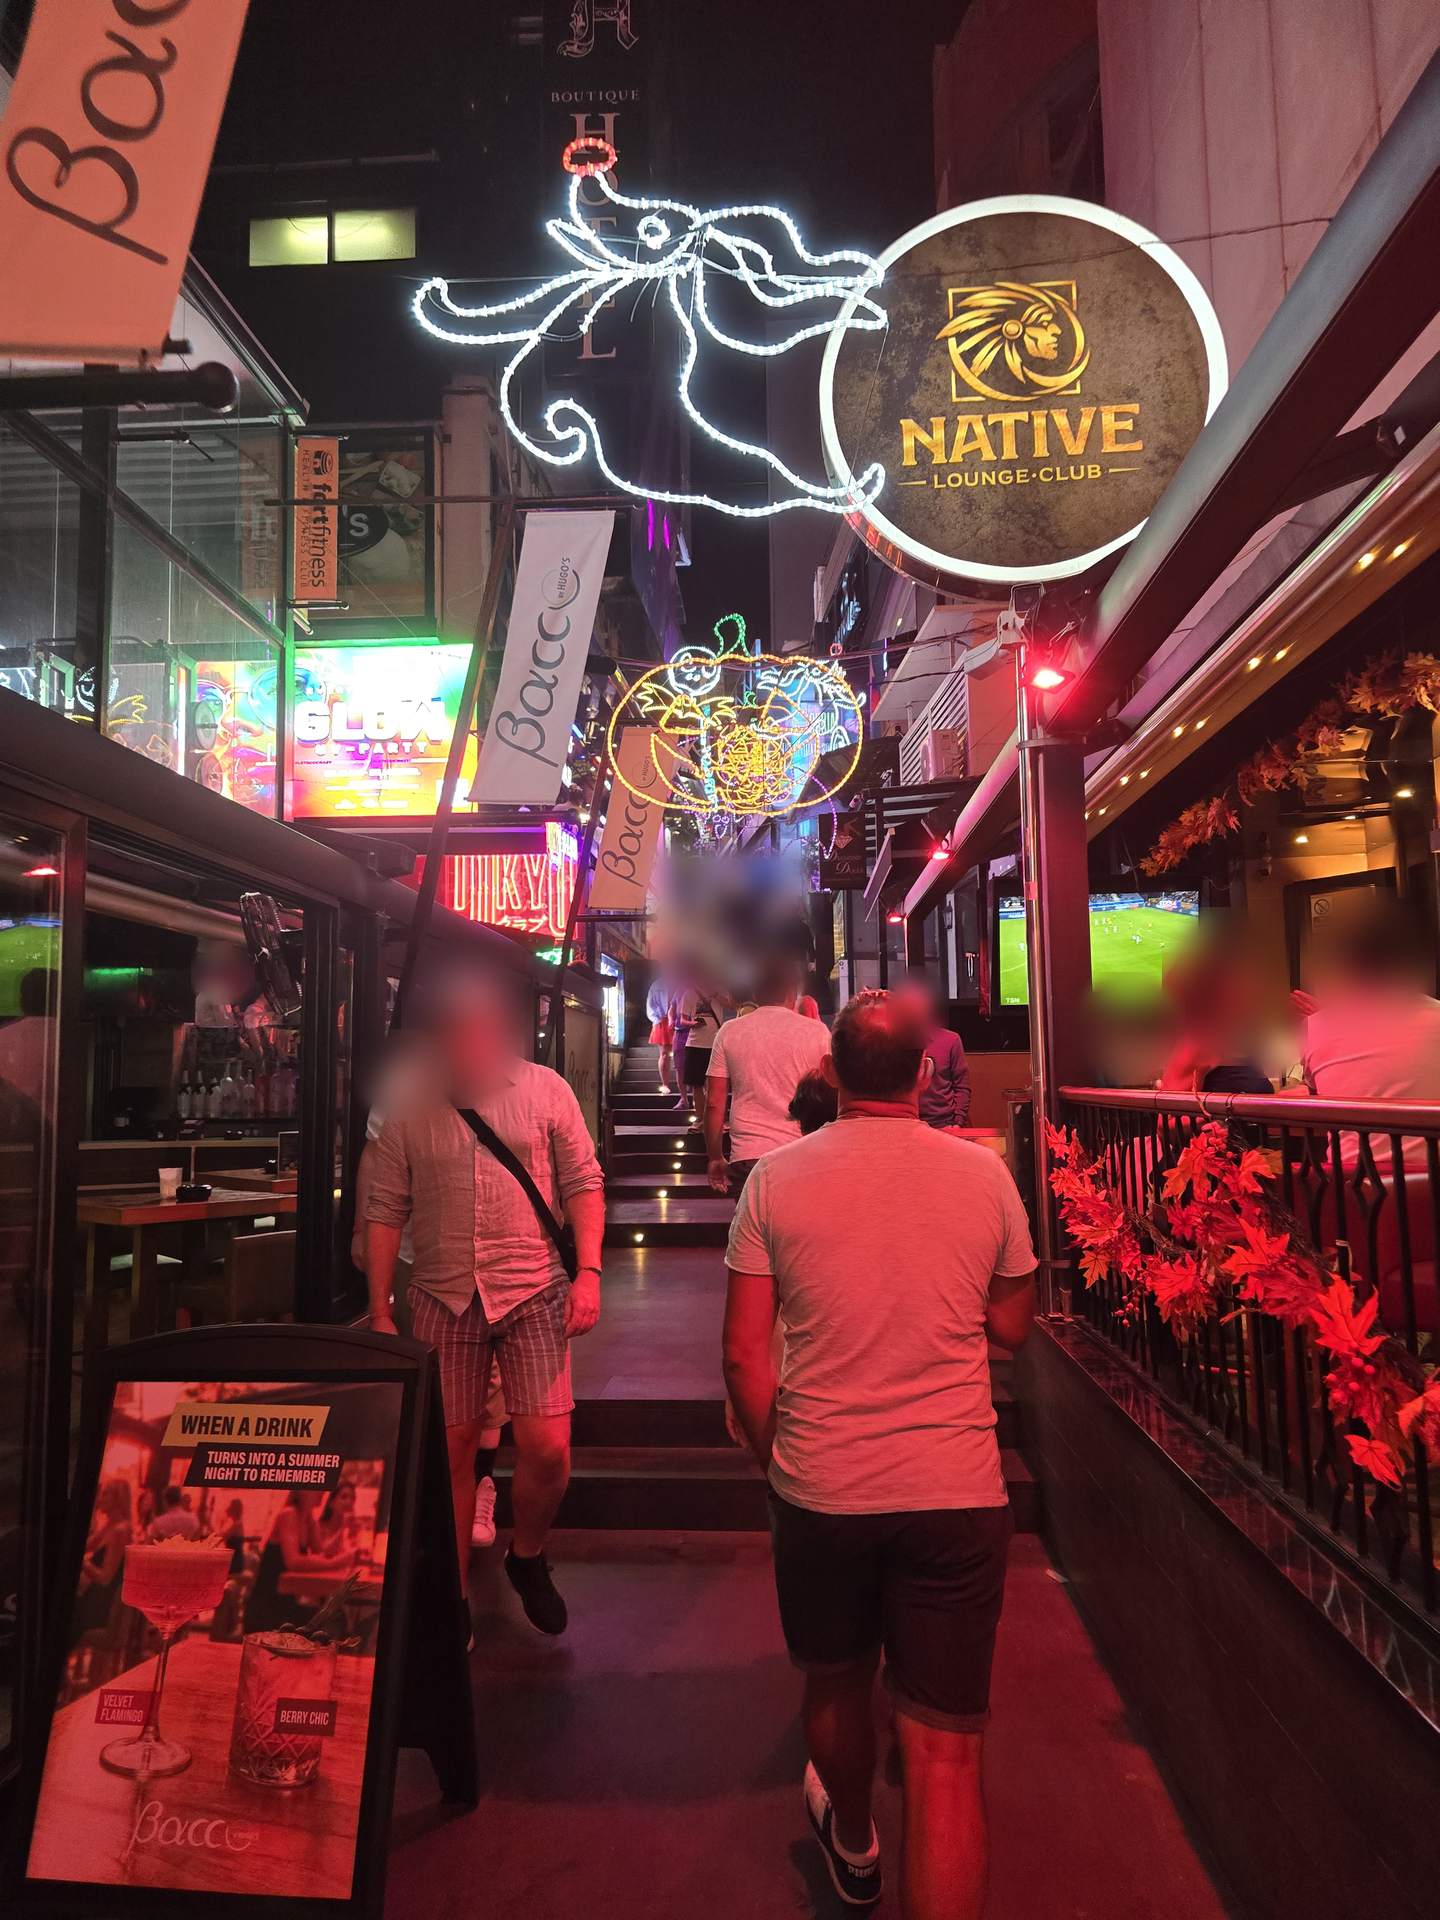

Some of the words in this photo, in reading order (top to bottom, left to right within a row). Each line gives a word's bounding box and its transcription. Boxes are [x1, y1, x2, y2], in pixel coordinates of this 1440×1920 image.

[551, 90, 640, 104] BOUTIQUE
[569, 112, 620, 360] HOTL
[900, 403, 1143, 466] NATIVE
[557, 557, 571, 592] HUGO'S
[181, 1415, 235, 1436] WHEN
[237, 1416, 250, 1436] A
[254, 1417, 314, 1438] DRINK
[207, 1451, 246, 1465] TURNS
[248, 1452, 276, 1467] INTO
[277, 1453, 286, 1467] A
[288, 1454, 340, 1468] SUMMER
[204, 1467, 242, 1481] NIGHT
[243, 1468, 258, 1481] TO
[260, 1469, 326, 1484] REMEMBER
[103, 1694, 135, 1708] VELVET
[100, 1708, 144, 1723] FLAMINGO
[280, 1710, 308, 1725] BERRY
[309, 1712, 329, 1726] CHIC
